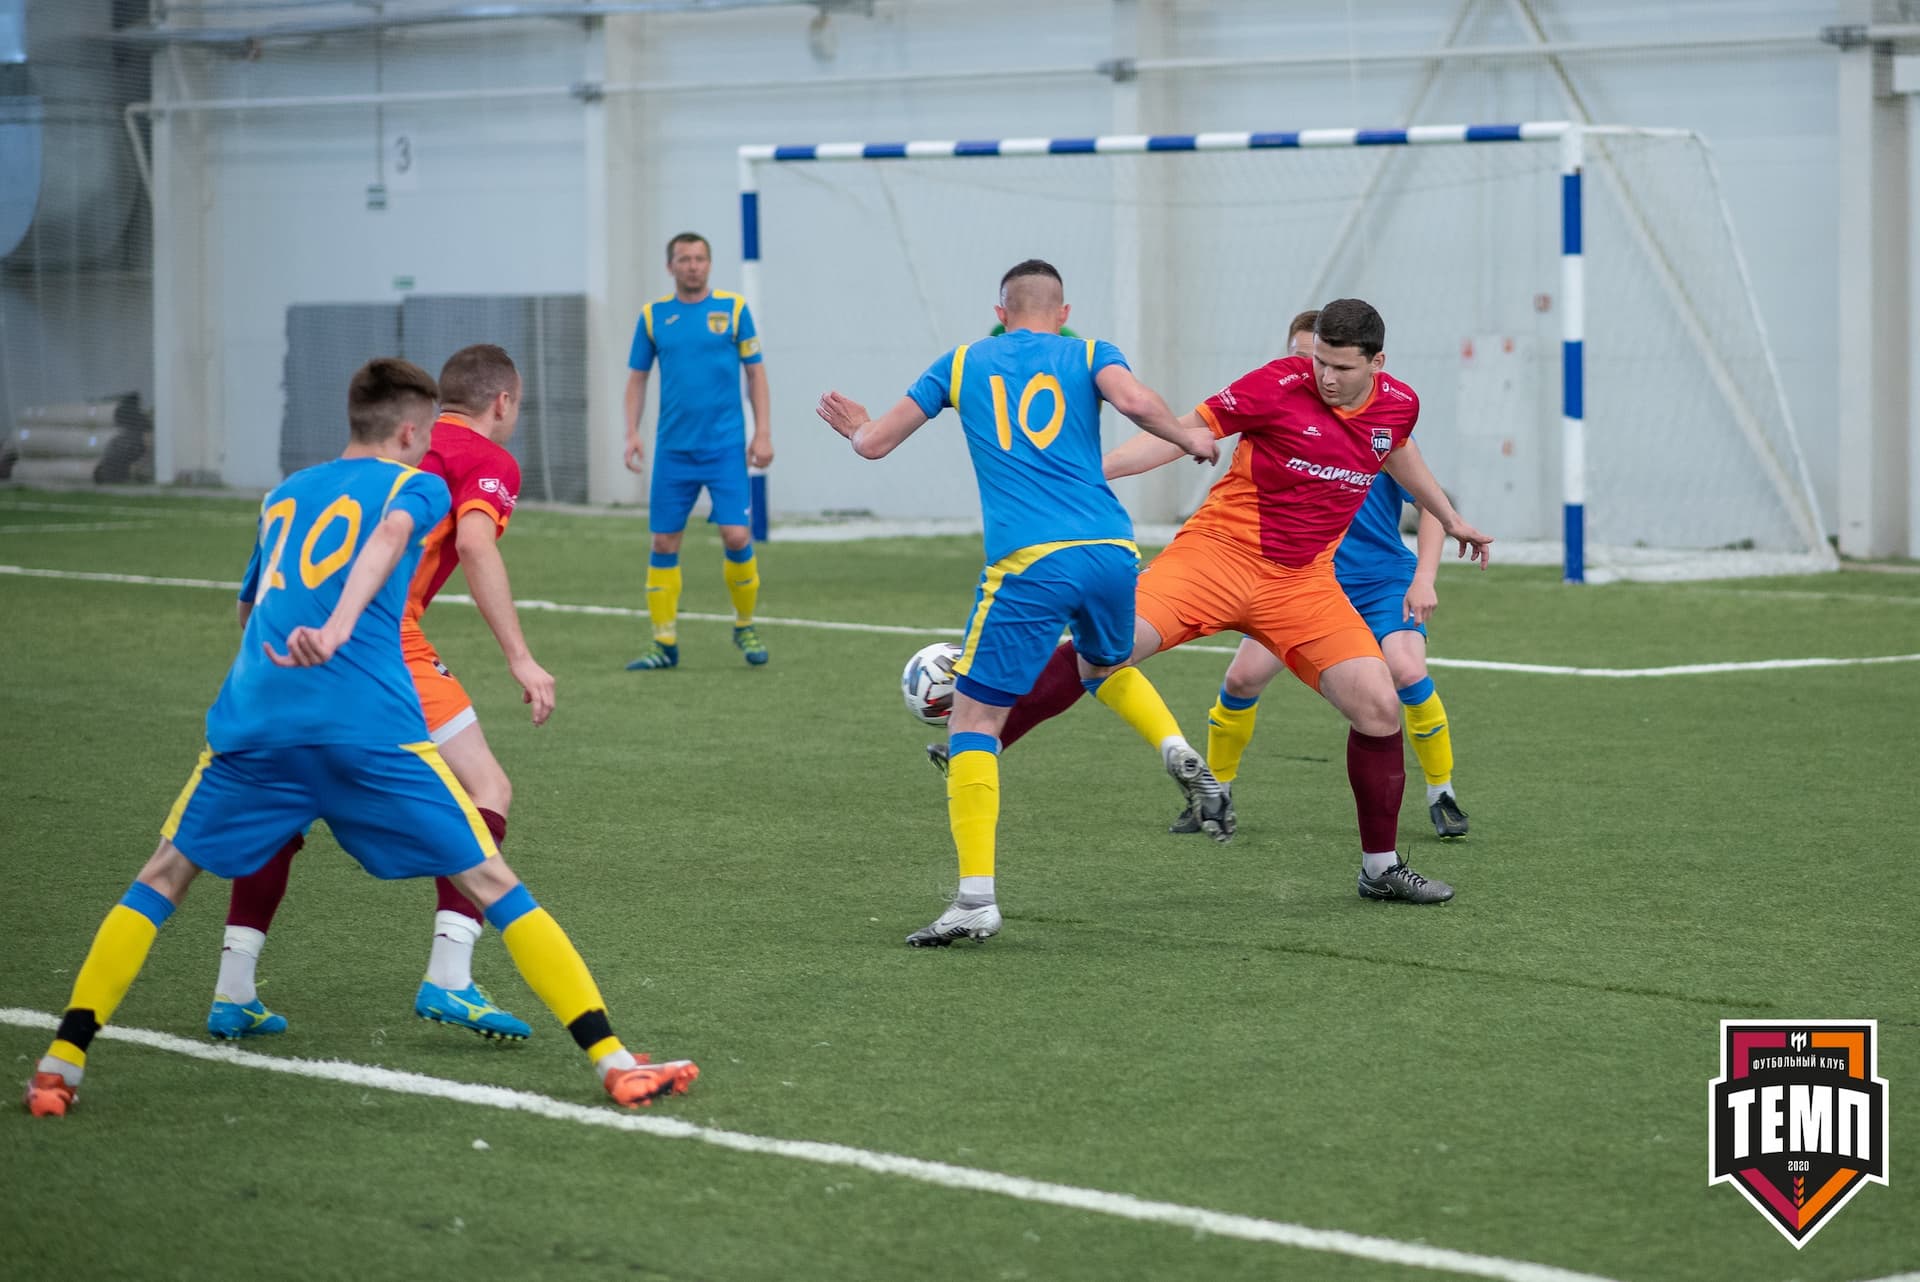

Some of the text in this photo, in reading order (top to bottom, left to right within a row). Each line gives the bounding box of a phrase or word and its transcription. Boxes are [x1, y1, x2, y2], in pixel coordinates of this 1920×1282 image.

[394, 136, 411, 174] 3
[989, 372, 1066, 451] 10
[256, 494, 362, 605] 20
